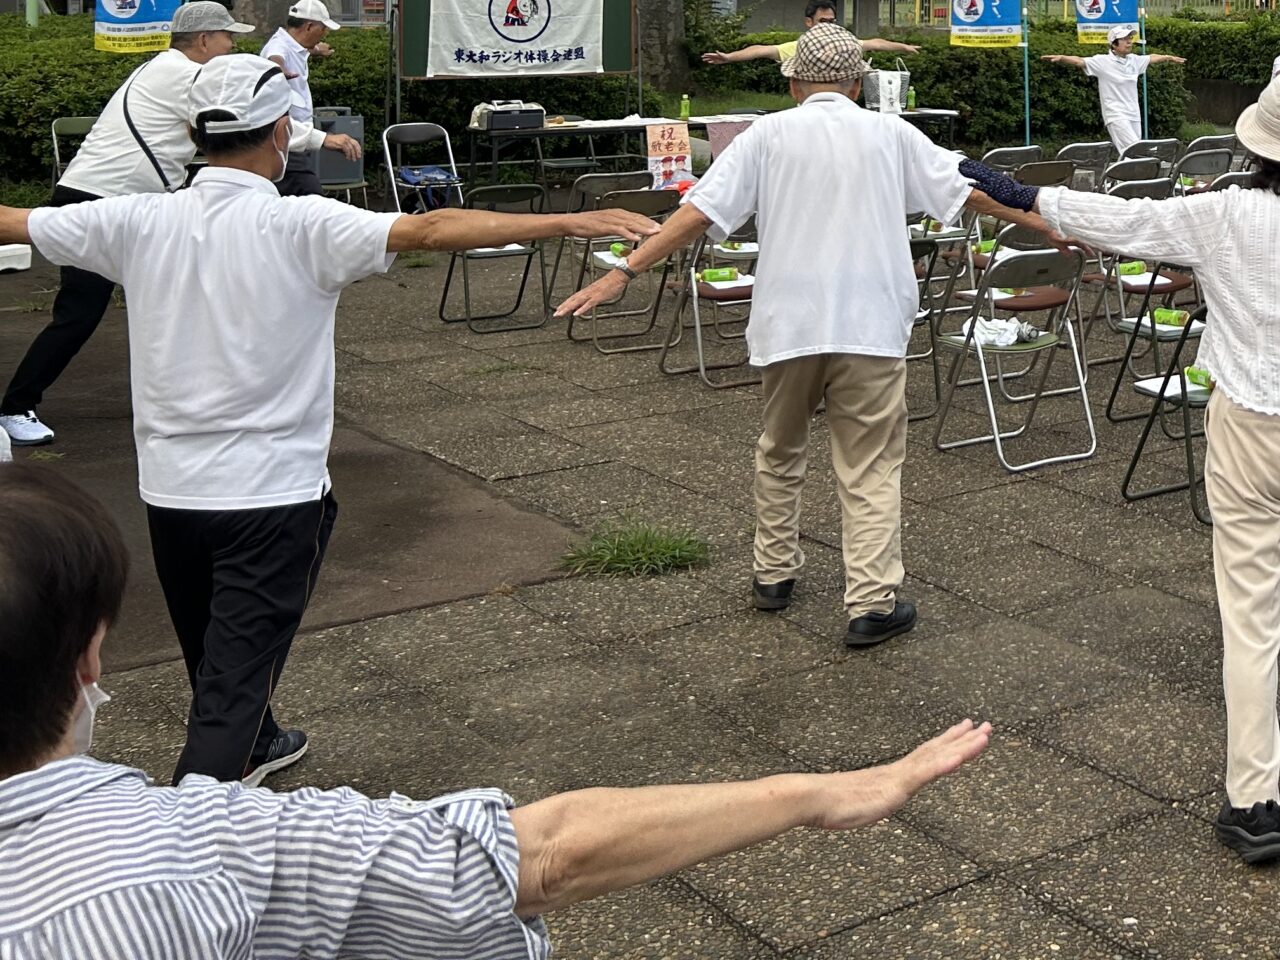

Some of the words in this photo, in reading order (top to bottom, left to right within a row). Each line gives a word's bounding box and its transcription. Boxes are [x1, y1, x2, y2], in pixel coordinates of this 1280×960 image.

[454, 47, 585, 64] 東大和ラジオ体操会連盟
